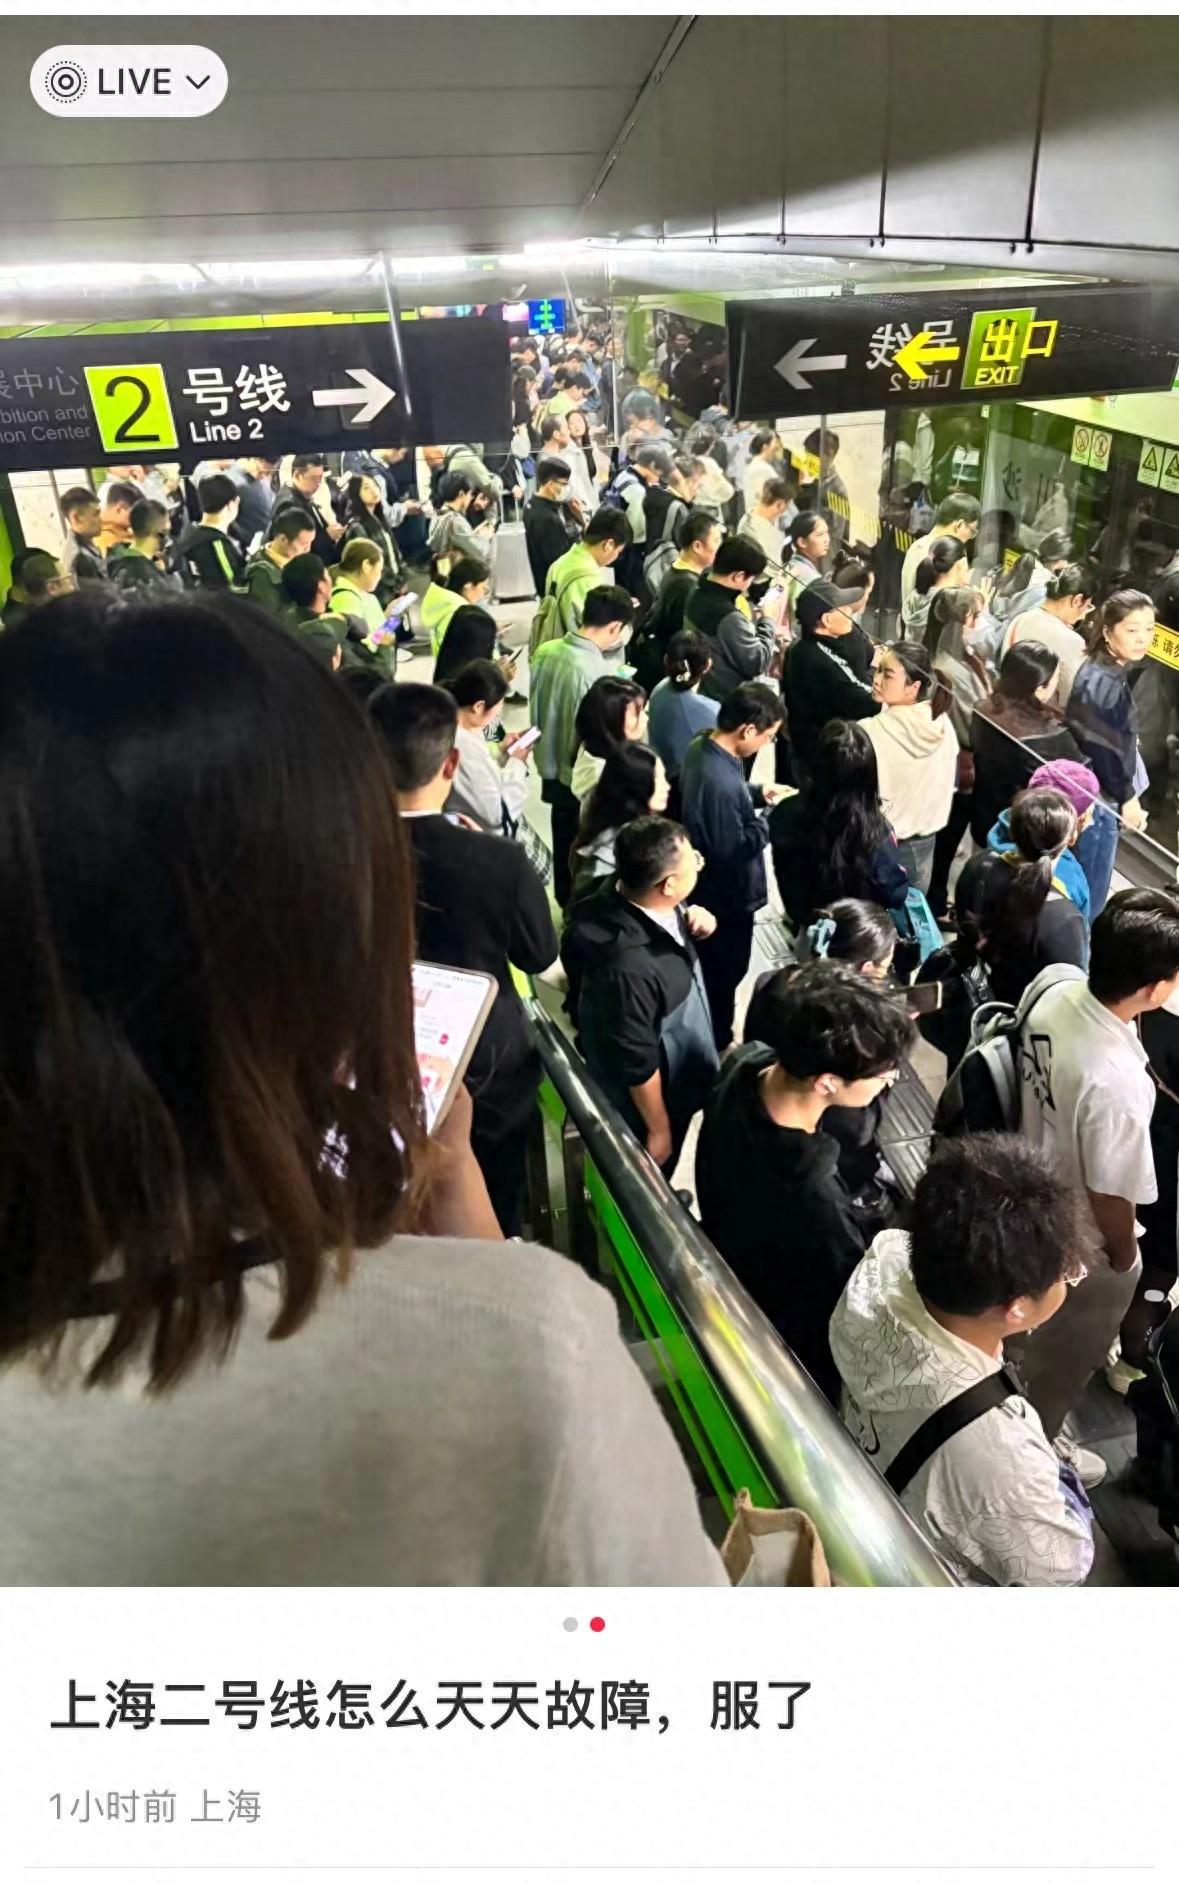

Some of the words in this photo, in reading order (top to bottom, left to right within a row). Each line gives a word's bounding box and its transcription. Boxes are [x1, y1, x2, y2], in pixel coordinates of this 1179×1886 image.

[979, 319, 1059, 363] 出口
[974, 366, 1019, 386] EXIT
[54, 404, 88, 421] and
[104, 375, 161, 443] 2
[182, 363, 291, 416] 号线
[31, 425, 91, 441] Center
[189, 420, 241, 443] Line
[247, 418, 264, 439] 2
